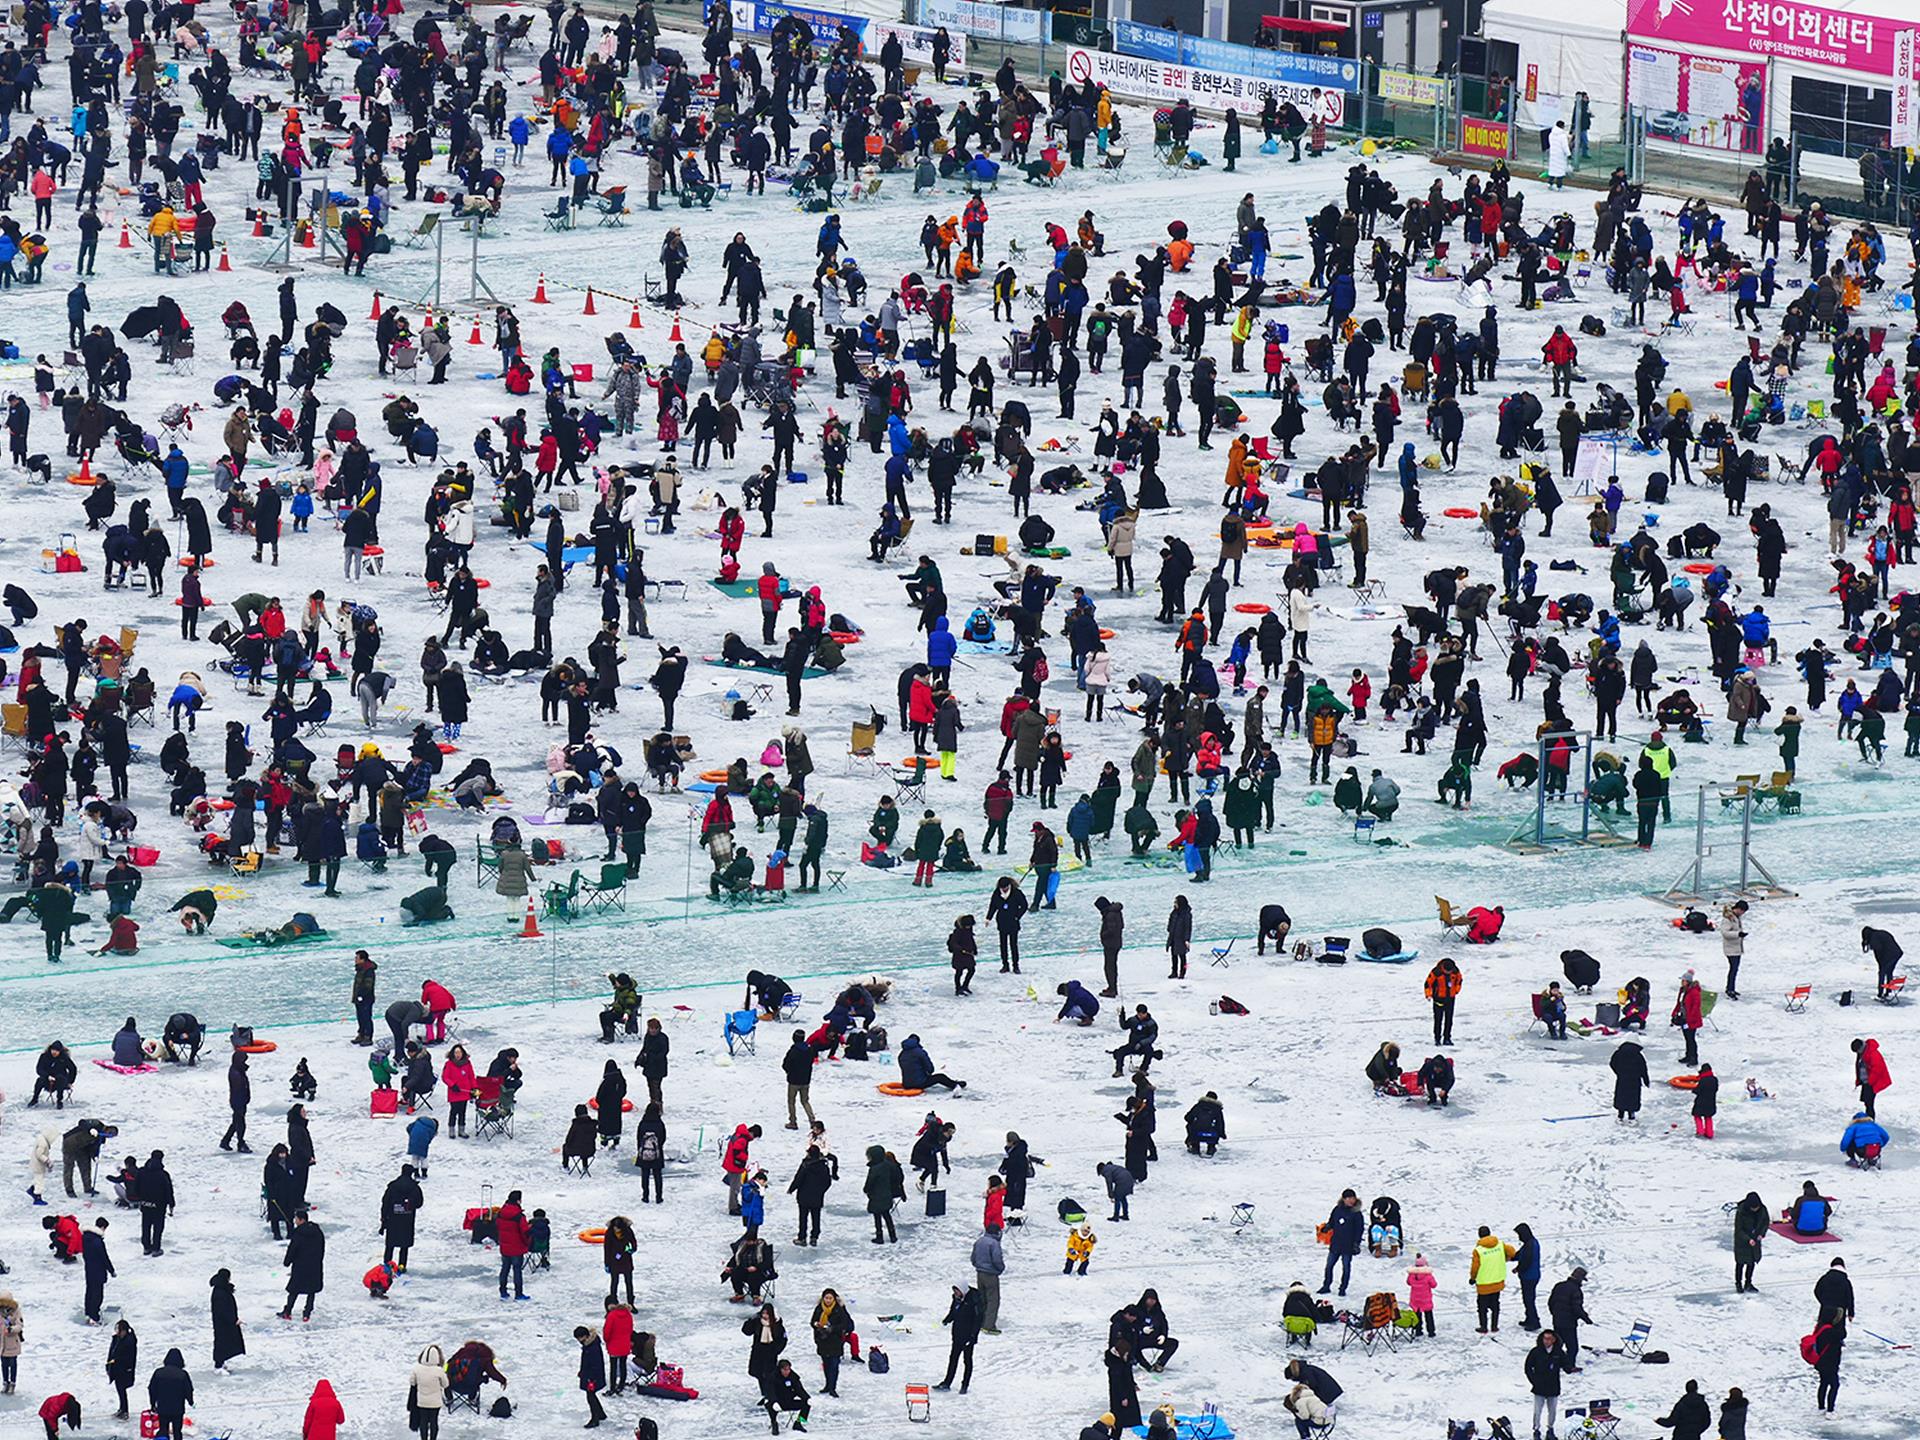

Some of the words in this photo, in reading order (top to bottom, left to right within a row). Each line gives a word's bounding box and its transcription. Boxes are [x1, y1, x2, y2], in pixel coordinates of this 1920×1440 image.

[1722, 0, 1874, 54] 산천어회센터
[1099, 57, 1158, 84] 낚시터에서는
[1163, 67, 1187, 89] 금연!
[1191, 71, 1243, 97] 흡연부스를
